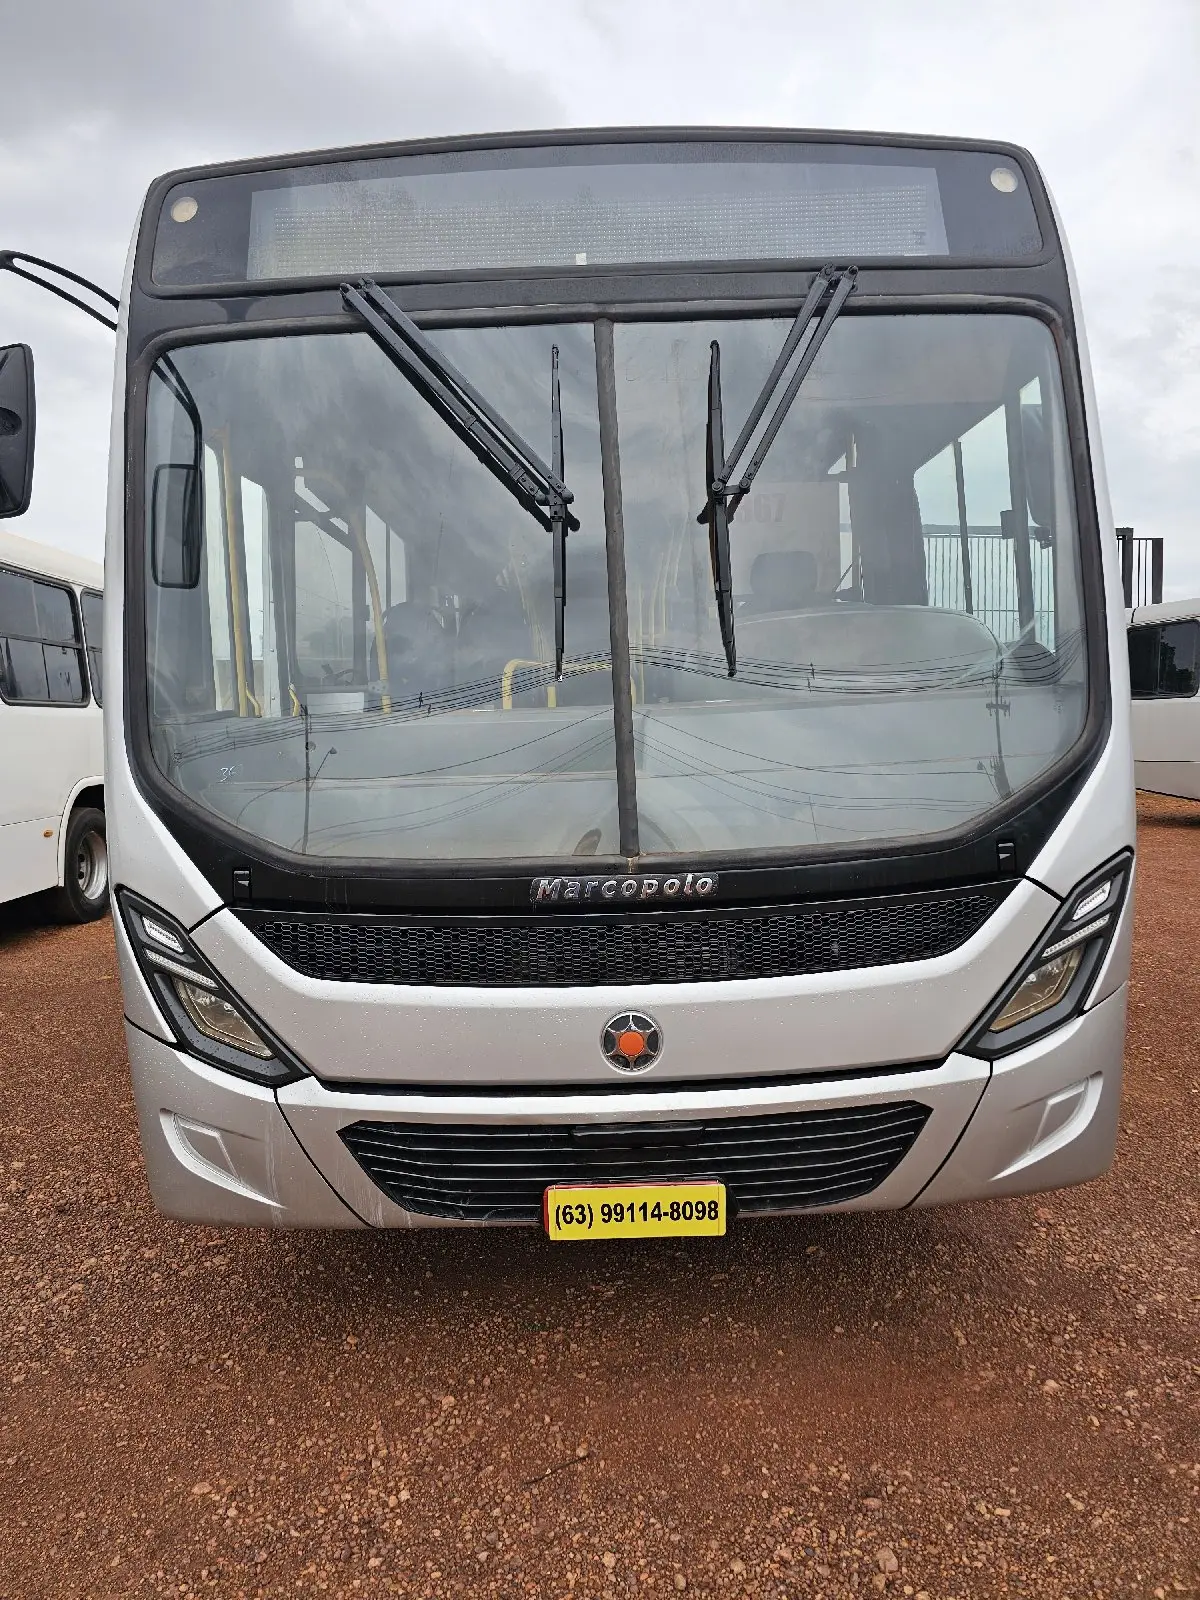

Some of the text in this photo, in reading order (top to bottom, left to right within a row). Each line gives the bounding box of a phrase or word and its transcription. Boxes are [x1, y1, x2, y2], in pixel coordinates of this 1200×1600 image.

[536, 873, 714, 900] Marcopolo
[555, 1200, 719, 1230] (63) 99114-8098
